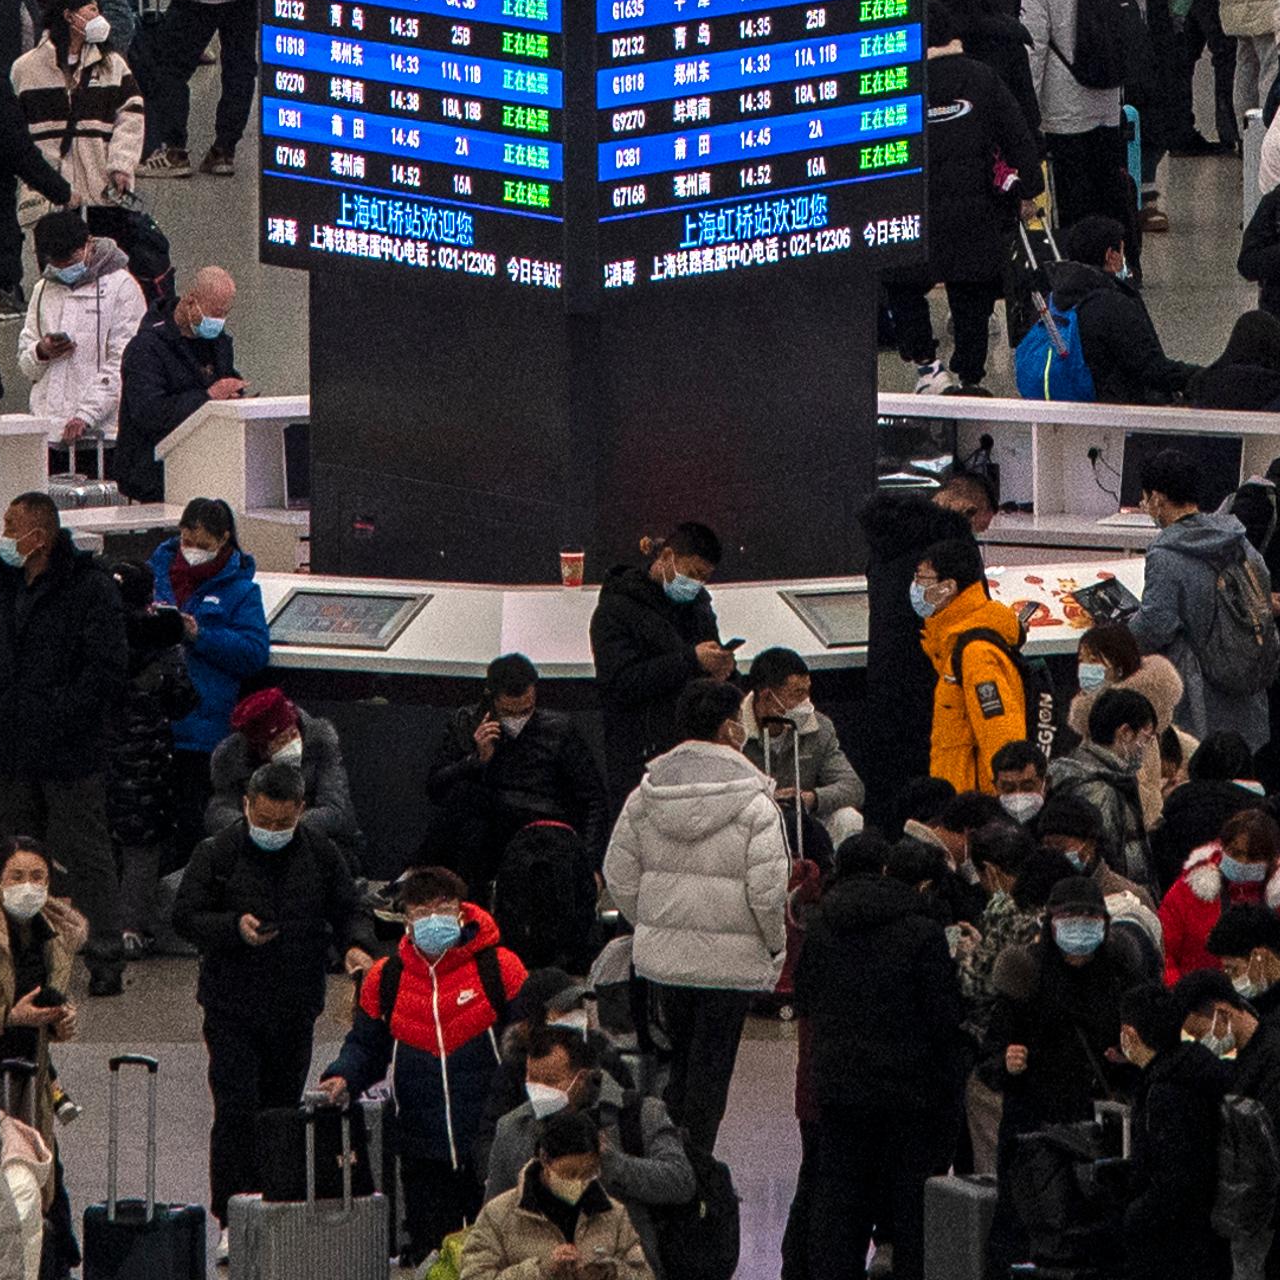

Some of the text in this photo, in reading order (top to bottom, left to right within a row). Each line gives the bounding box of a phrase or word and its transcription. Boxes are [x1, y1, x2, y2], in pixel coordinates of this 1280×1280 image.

[390, 17, 419, 38] 14:35
[451, 26, 470, 46] 25B
[503, 32, 549, 58] 正在检票
[612, 36, 645, 58] D2132
[740, 18, 771, 39] 14:35
[806, 9, 825, 29] 25B
[612, 30, 908, 95] G1818 郑州东 14:33 正在检票
[276, 35, 549, 95] G1818 郑州东 14:33 正在检票
[276, 71, 305, 93] G9270
[390, 90, 419, 112] 14:38
[503, 106, 549, 132] 正在检票
[612, 110, 645, 132] G9270
[740, 91, 771, 113] 14:38
[860, 67, 908, 95] 正在检票
[278, 108, 301, 128] D381
[391, 127, 420, 148] 14:45
[455, 138, 468, 156] 2A
[503, 144, 549, 169] 正在检票
[616, 147, 641, 168] D381
[740, 127, 771, 149] 14:45
[808, 120, 823, 139] 2A
[860, 104, 908, 131] 正在检票
[276, 146, 306, 168] G7168
[391, 165, 420, 187] 14:52
[453, 175, 471, 195] 16A
[503, 181, 550, 207] 正在检票
[612, 184, 645, 208] G7168
[740, 165, 772, 187] 14:52
[807, 157, 826, 176] 16A
[860, 140, 908, 170] 正在检票
[336, 192, 474, 246] 上海虹桥站欢迎您
[679, 193, 828, 249] 上海虹桥站欢迎您
